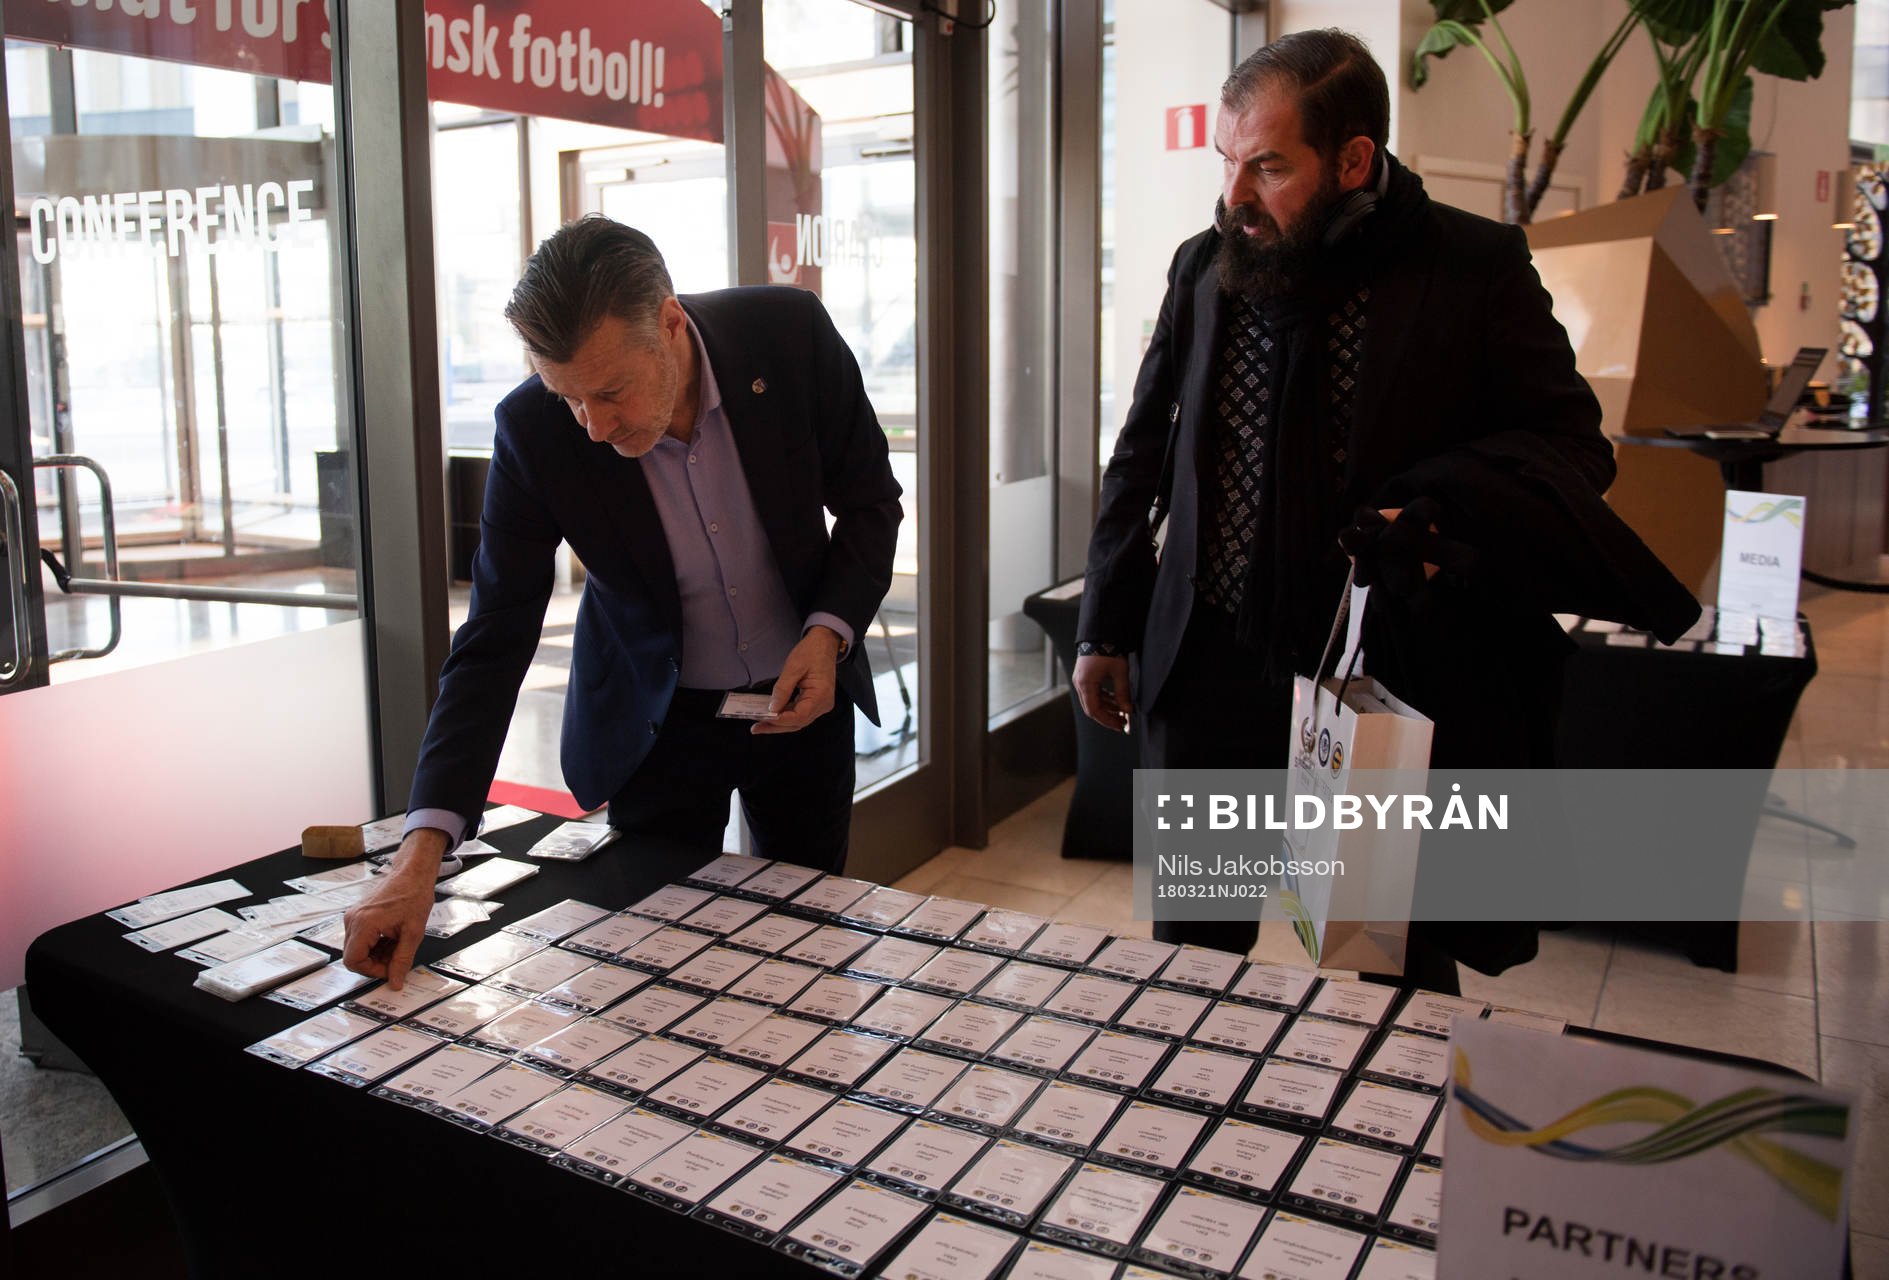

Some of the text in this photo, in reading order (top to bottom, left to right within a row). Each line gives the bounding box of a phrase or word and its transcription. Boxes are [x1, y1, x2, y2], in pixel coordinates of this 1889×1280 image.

[509, 13, 665, 108] fotboll!
[30, 179, 313, 264] CONFERENCE
[1739, 551, 1781, 568] MEDIA
